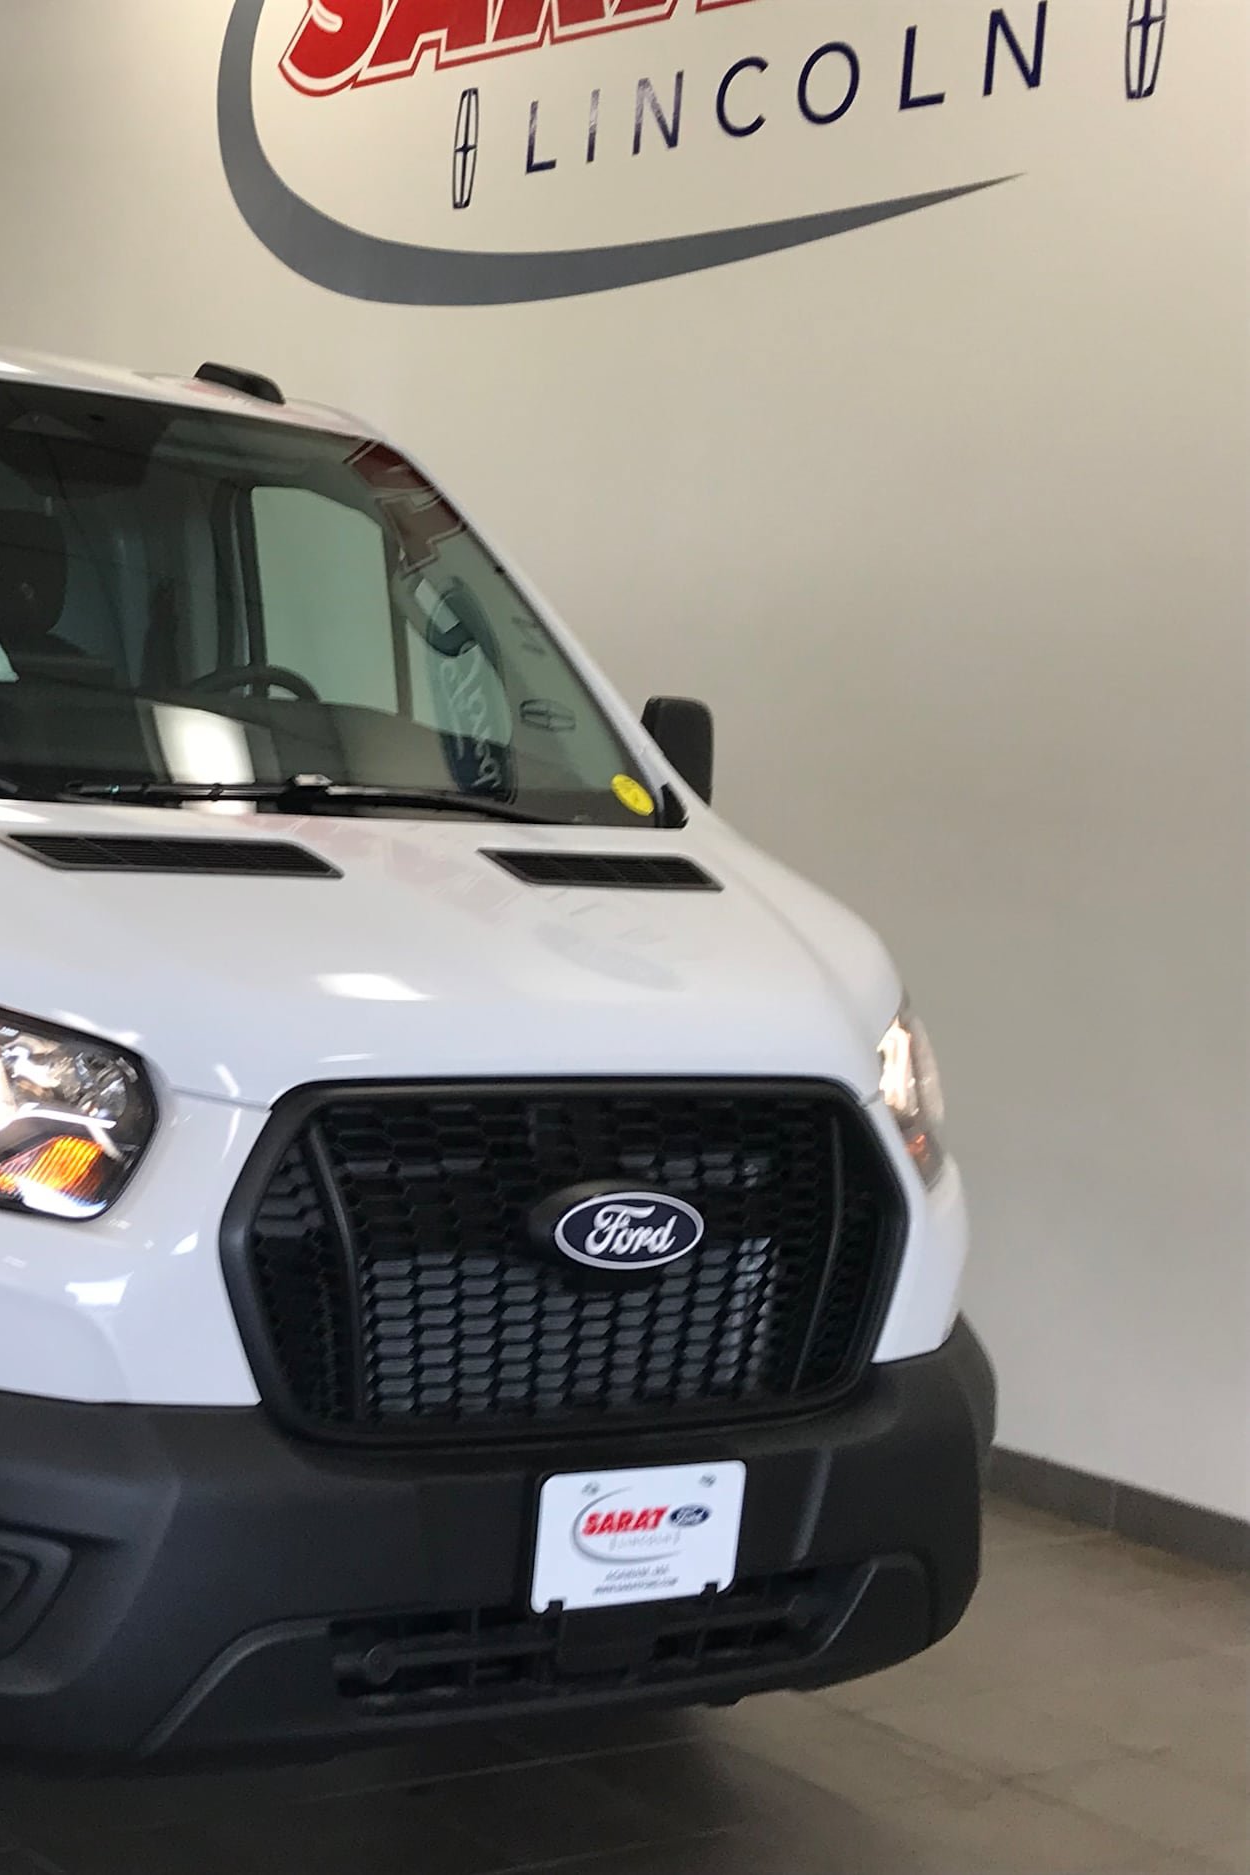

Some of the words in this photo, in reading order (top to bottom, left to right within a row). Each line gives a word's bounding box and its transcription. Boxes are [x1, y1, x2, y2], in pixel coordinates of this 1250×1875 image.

[524, 0, 1048, 174] LINCOLN
[584, 1203, 679, 1256] Ford
[582, 1504, 668, 1536] SARAT
